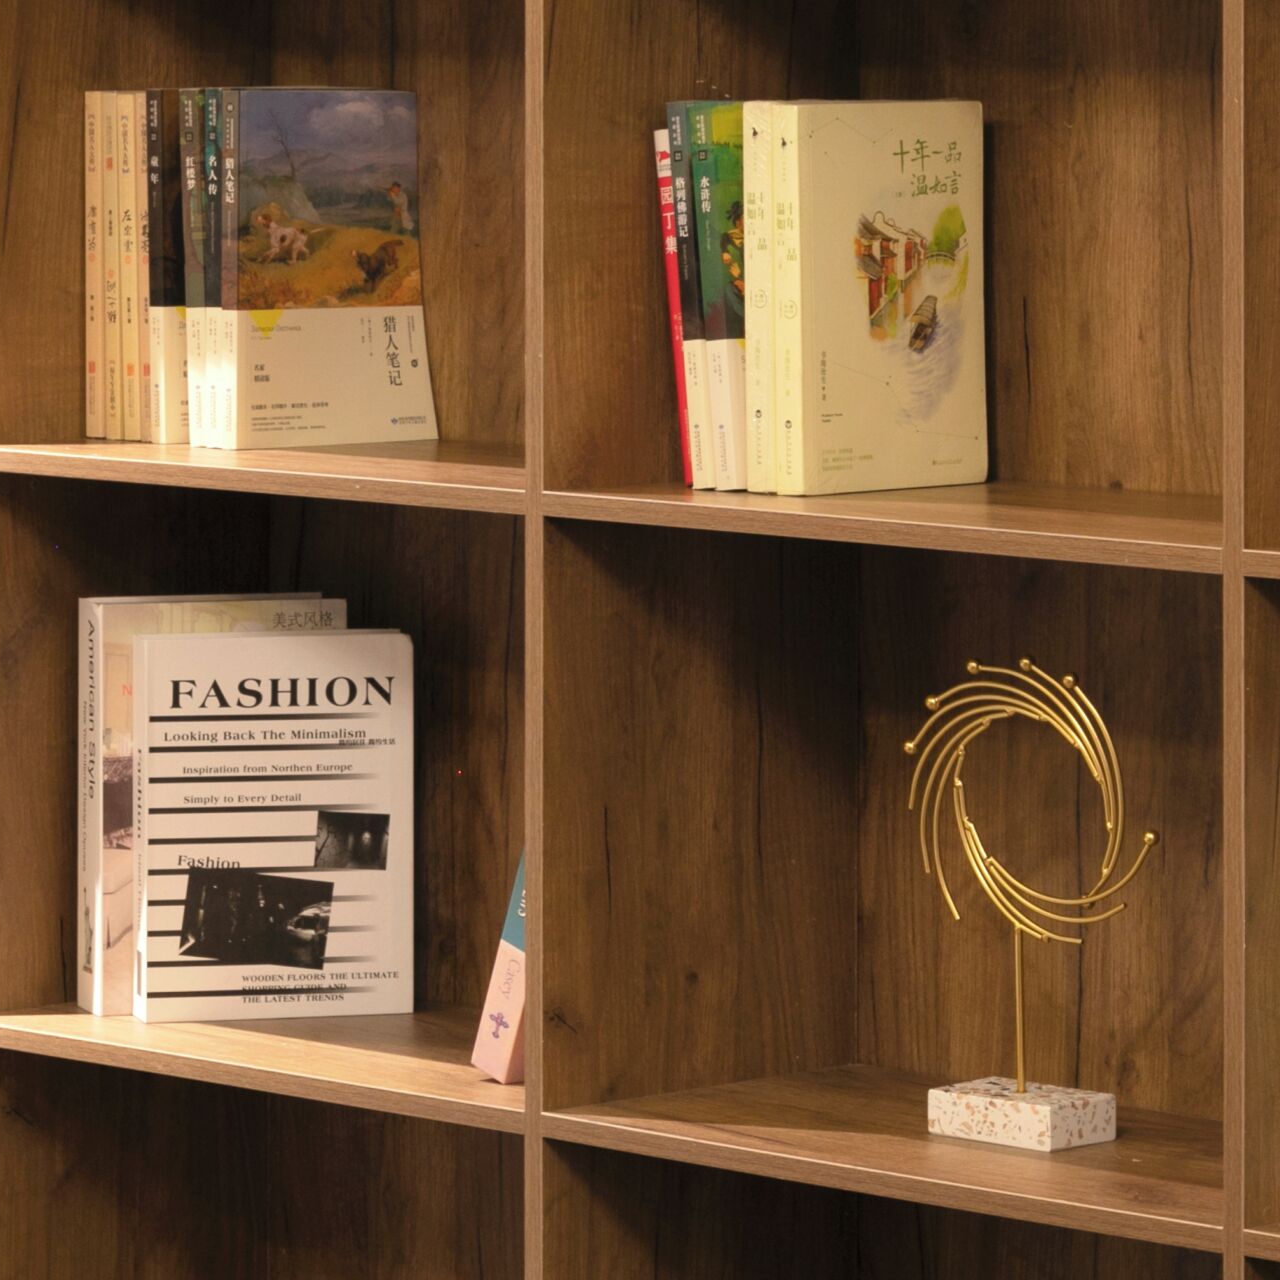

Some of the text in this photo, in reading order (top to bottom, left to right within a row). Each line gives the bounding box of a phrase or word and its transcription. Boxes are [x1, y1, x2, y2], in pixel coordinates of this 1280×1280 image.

[892, 139, 963, 175] 十年一品
[208, 155, 218, 197] 名人传
[699, 175, 713, 214] 水浒传
[660, 186, 678, 255] 园丁集
[383, 314, 403, 387] 猎人笔记
[272, 608, 334, 630] 美式风格
[169, 676, 396, 710] FASHION
[87, 618, 99, 801] American Style
[163, 727, 367, 744] Looking Back The Minimalism
[182, 762, 353, 776] Inspiration from Northen Europe
[183, 792, 302, 806] Simply to Every Detail
[177, 854, 242, 870] Fashion
[241, 970, 400, 982] WOODEN FLOORS THE ULTIMATE
[241, 992, 345, 1003] THE LATEST TRENDS
